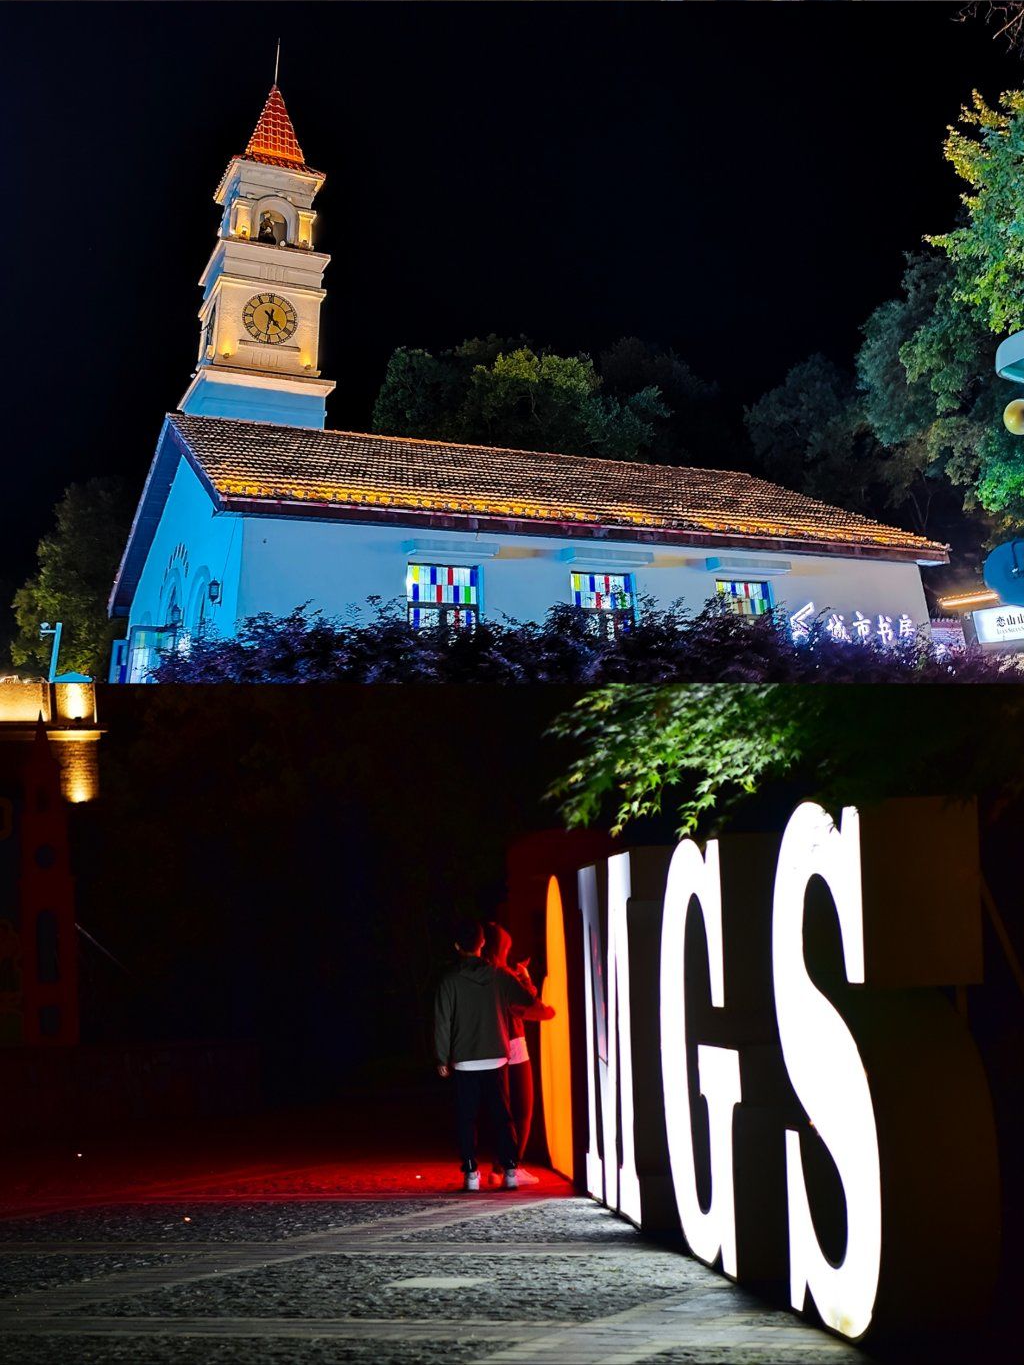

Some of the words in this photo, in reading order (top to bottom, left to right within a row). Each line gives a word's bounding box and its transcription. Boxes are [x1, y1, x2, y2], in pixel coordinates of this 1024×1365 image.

[826, 610, 916, 645] 城市书房
[578, 802, 882, 1338] MGS
